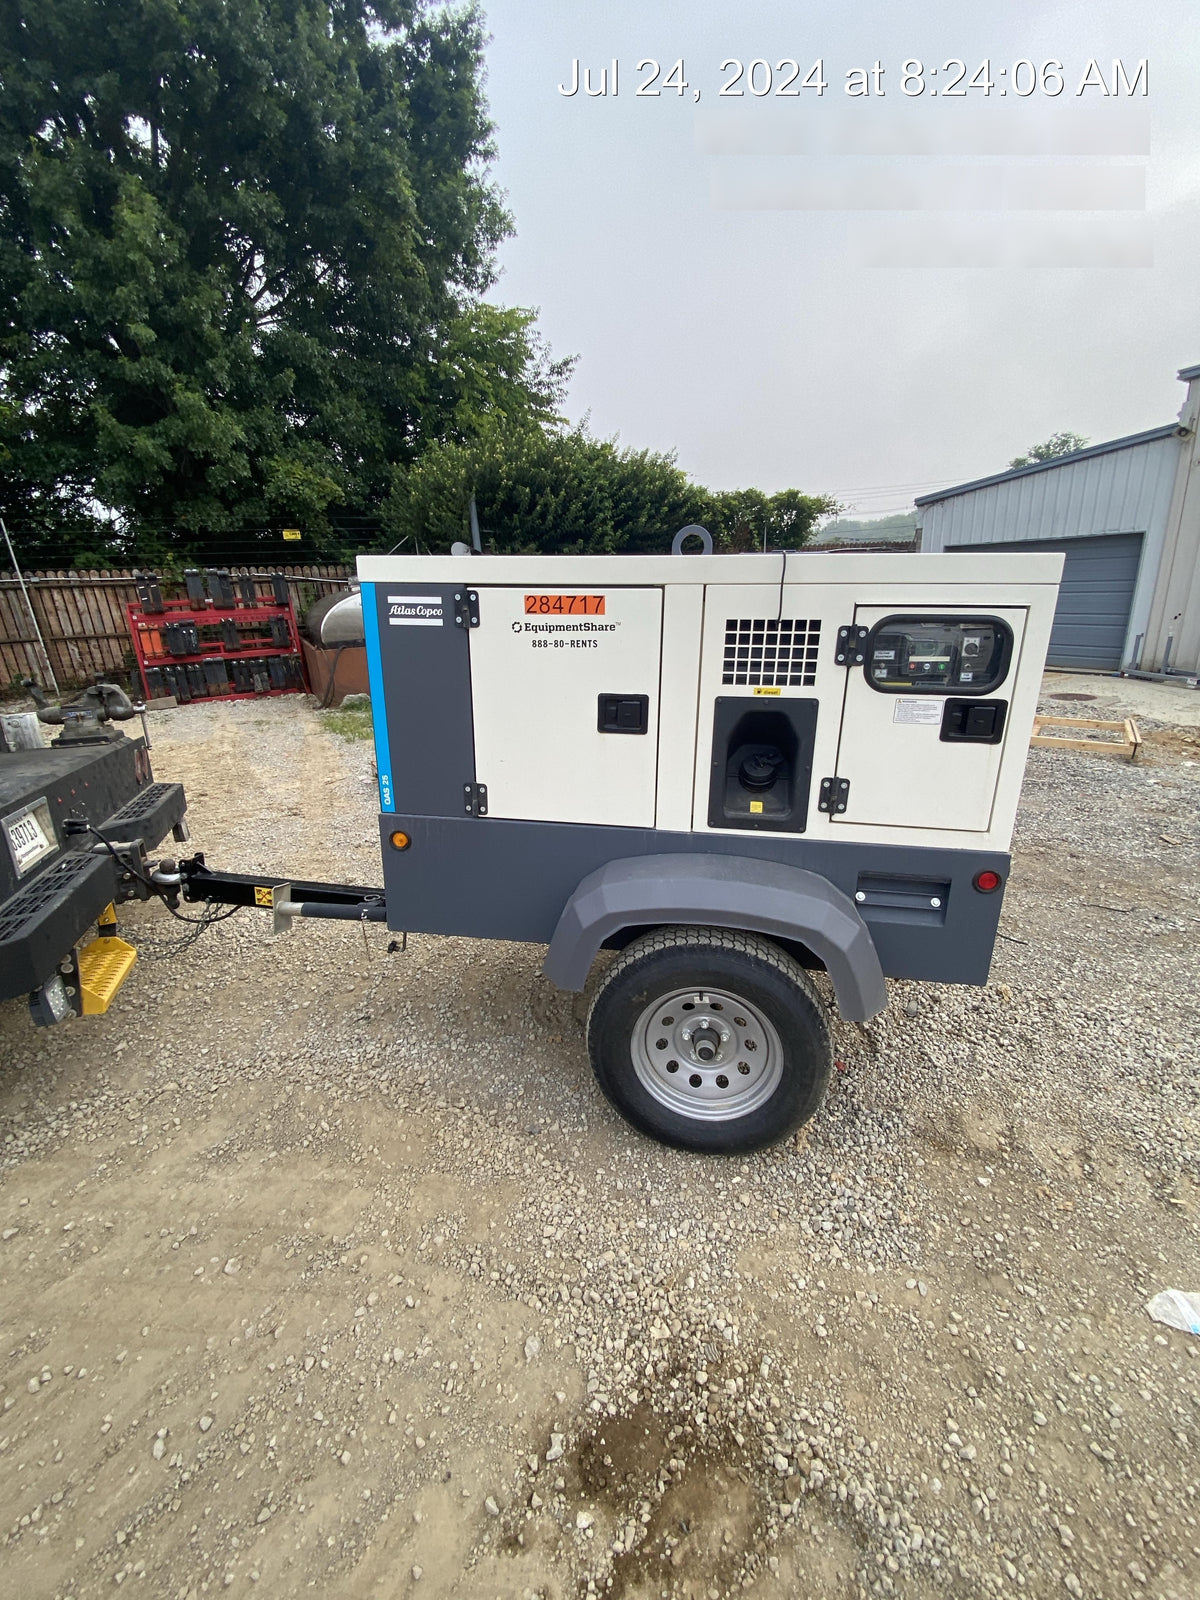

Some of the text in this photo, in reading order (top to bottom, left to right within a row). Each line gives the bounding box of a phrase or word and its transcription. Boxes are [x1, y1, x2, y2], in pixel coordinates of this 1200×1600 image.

[388, 604, 443, 617] Atlas Copco
[526, 595, 605, 614] 284717
[531, 639, 598, 649] 888-80-RENTS
